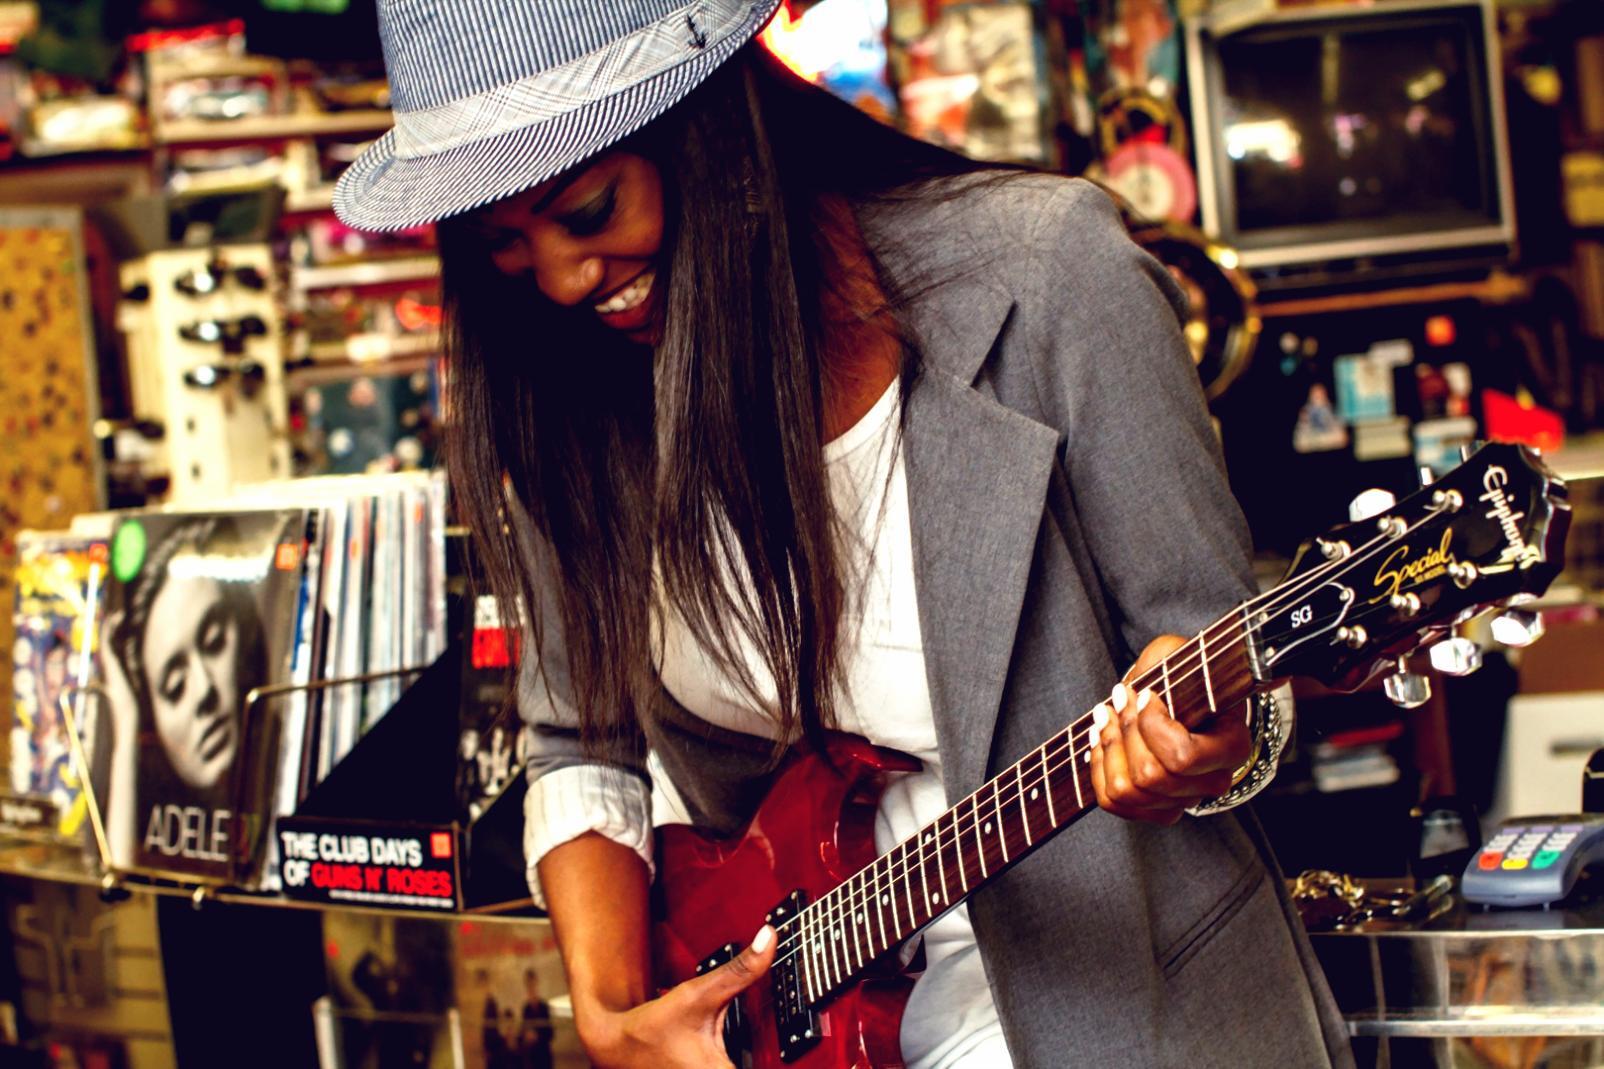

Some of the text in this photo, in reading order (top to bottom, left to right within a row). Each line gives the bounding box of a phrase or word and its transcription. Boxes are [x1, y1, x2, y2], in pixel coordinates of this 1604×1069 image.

[1368, 527, 1456, 604] Special
[1290, 604, 1313, 628] SG
[143, 804, 232, 862] ADELE
[281, 831, 423, 867] THE CLUB DAYS
[283, 859, 310, 887] OF
[311, 862, 363, 889] GUNS
[386, 868, 453, 897] ROSES
